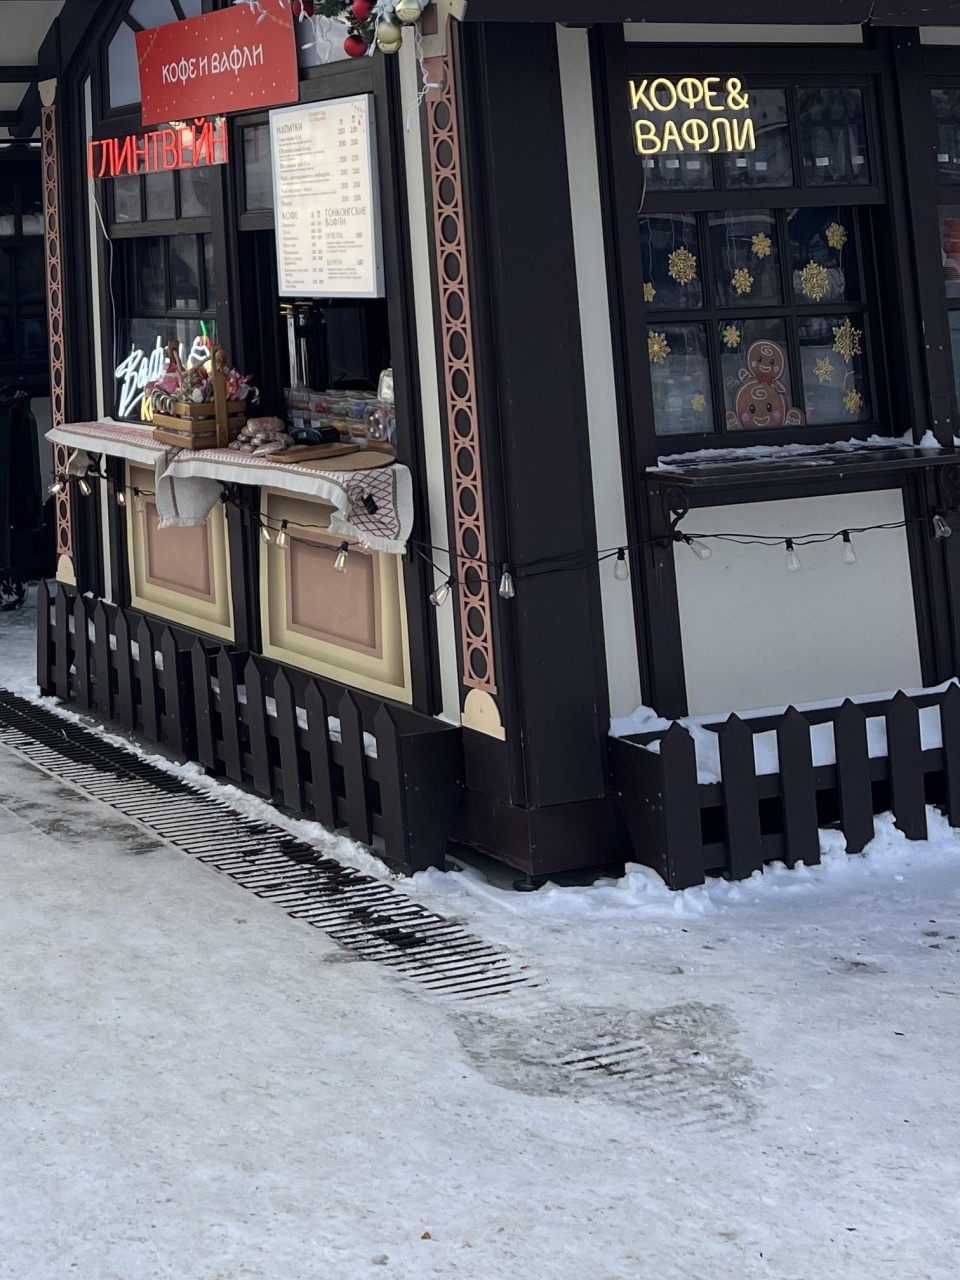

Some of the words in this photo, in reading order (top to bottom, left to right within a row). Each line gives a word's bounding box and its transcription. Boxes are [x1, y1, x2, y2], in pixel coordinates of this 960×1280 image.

[161, 57, 197, 85] КОФЕ
[199, 56, 209, 77] И
[211, 44, 264, 75] ВАФЛИ
[276, 123, 303, 134] НАПИТКИ
[634, 117, 756, 154] ВАФЛИ
[351, 138, 359, 146] 250
[88, 118, 228, 180] ГЛИНТВЕЙН
[351, 154, 359, 162] 250
[340, 168, 348, 176] 200
[352, 167, 360, 175] 250
[282, 210, 298, 220] КОФЕ
[325, 206, 367, 217] ГОНКОНГСКИЕ
[325, 217, 346, 226] ВАФЛИ
